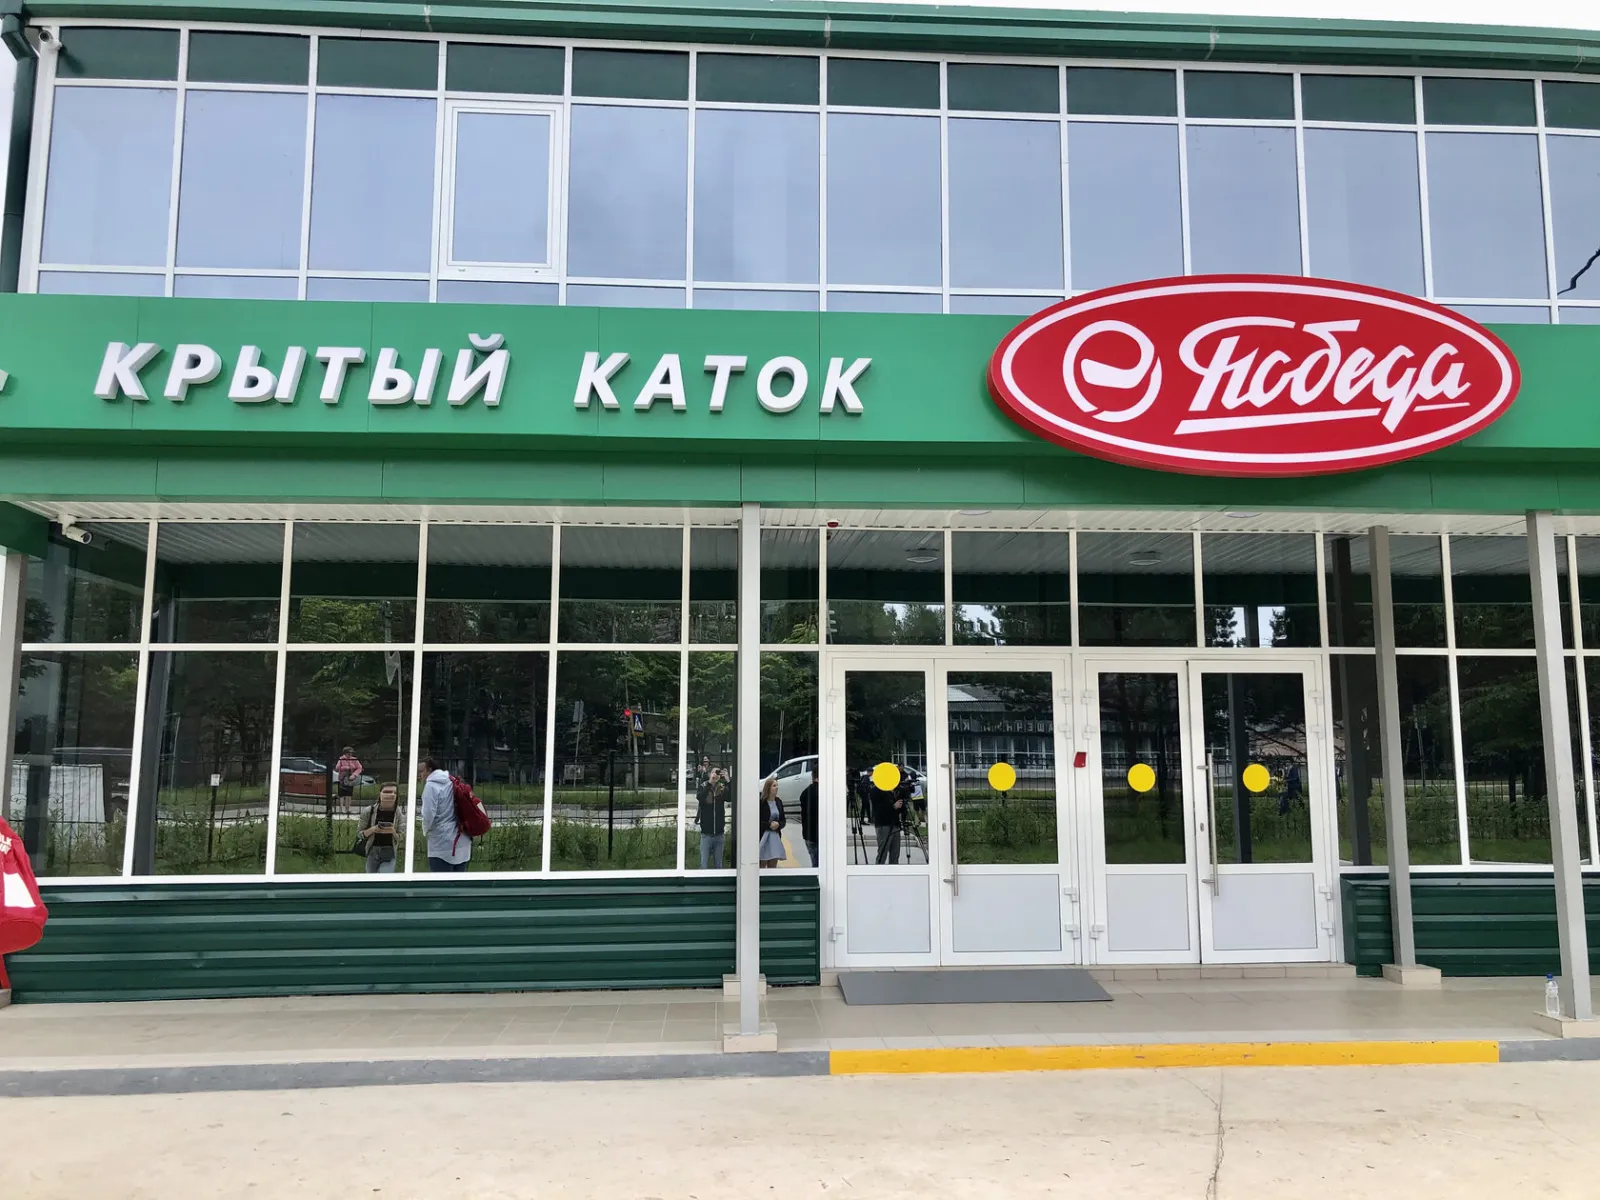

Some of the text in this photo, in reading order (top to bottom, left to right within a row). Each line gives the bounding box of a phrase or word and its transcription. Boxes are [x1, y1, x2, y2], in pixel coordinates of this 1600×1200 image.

[94, 333, 872, 414] КРЫТЫЙ КАТОК
[1174, 316, 1472, 434] Победа
